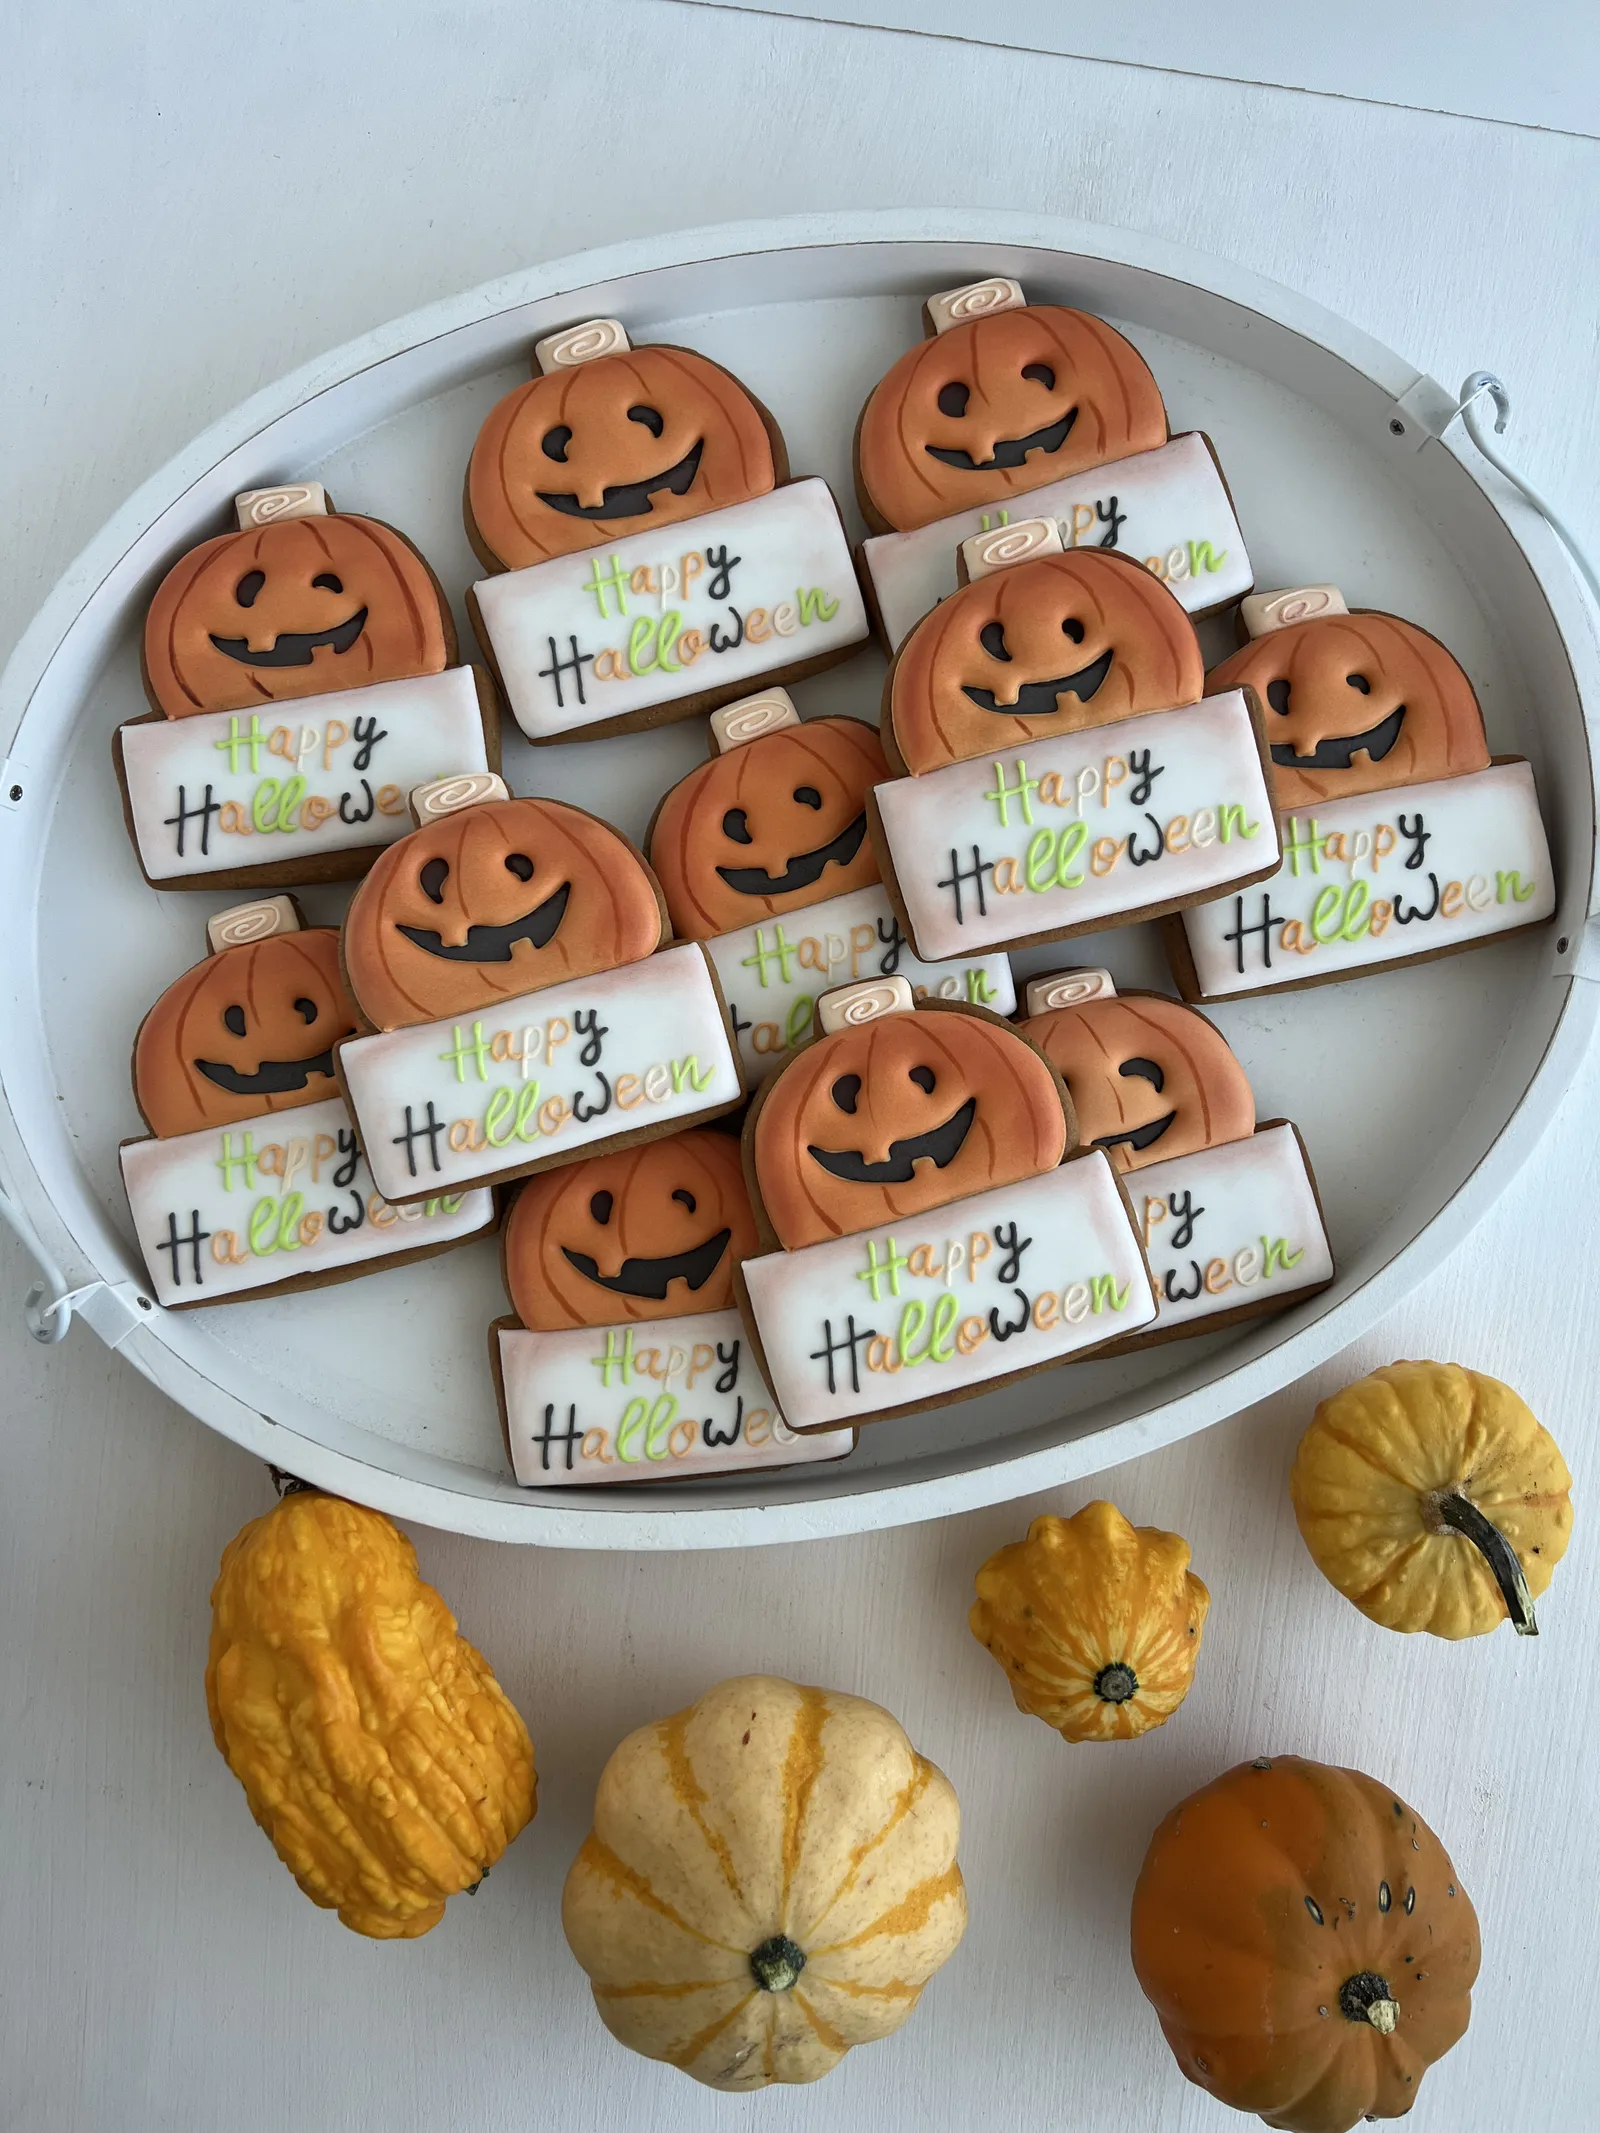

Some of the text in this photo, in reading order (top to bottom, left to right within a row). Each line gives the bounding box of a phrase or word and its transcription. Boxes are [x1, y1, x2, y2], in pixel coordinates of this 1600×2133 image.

[583, 544, 741, 619] Happy
[215, 714, 388, 773] Happy
[164, 772, 446, 858] Hallowe
[985, 748, 1164, 827] Happy
[1283, 813, 1432, 881] Happy
[741, 916, 907, 988] Happy
[440, 1008, 609, 1083] Happy
[216, 1128, 361, 1195] Happy
[856, 1221, 1033, 1301] Happy
[592, 1328, 740, 1393] Happy
